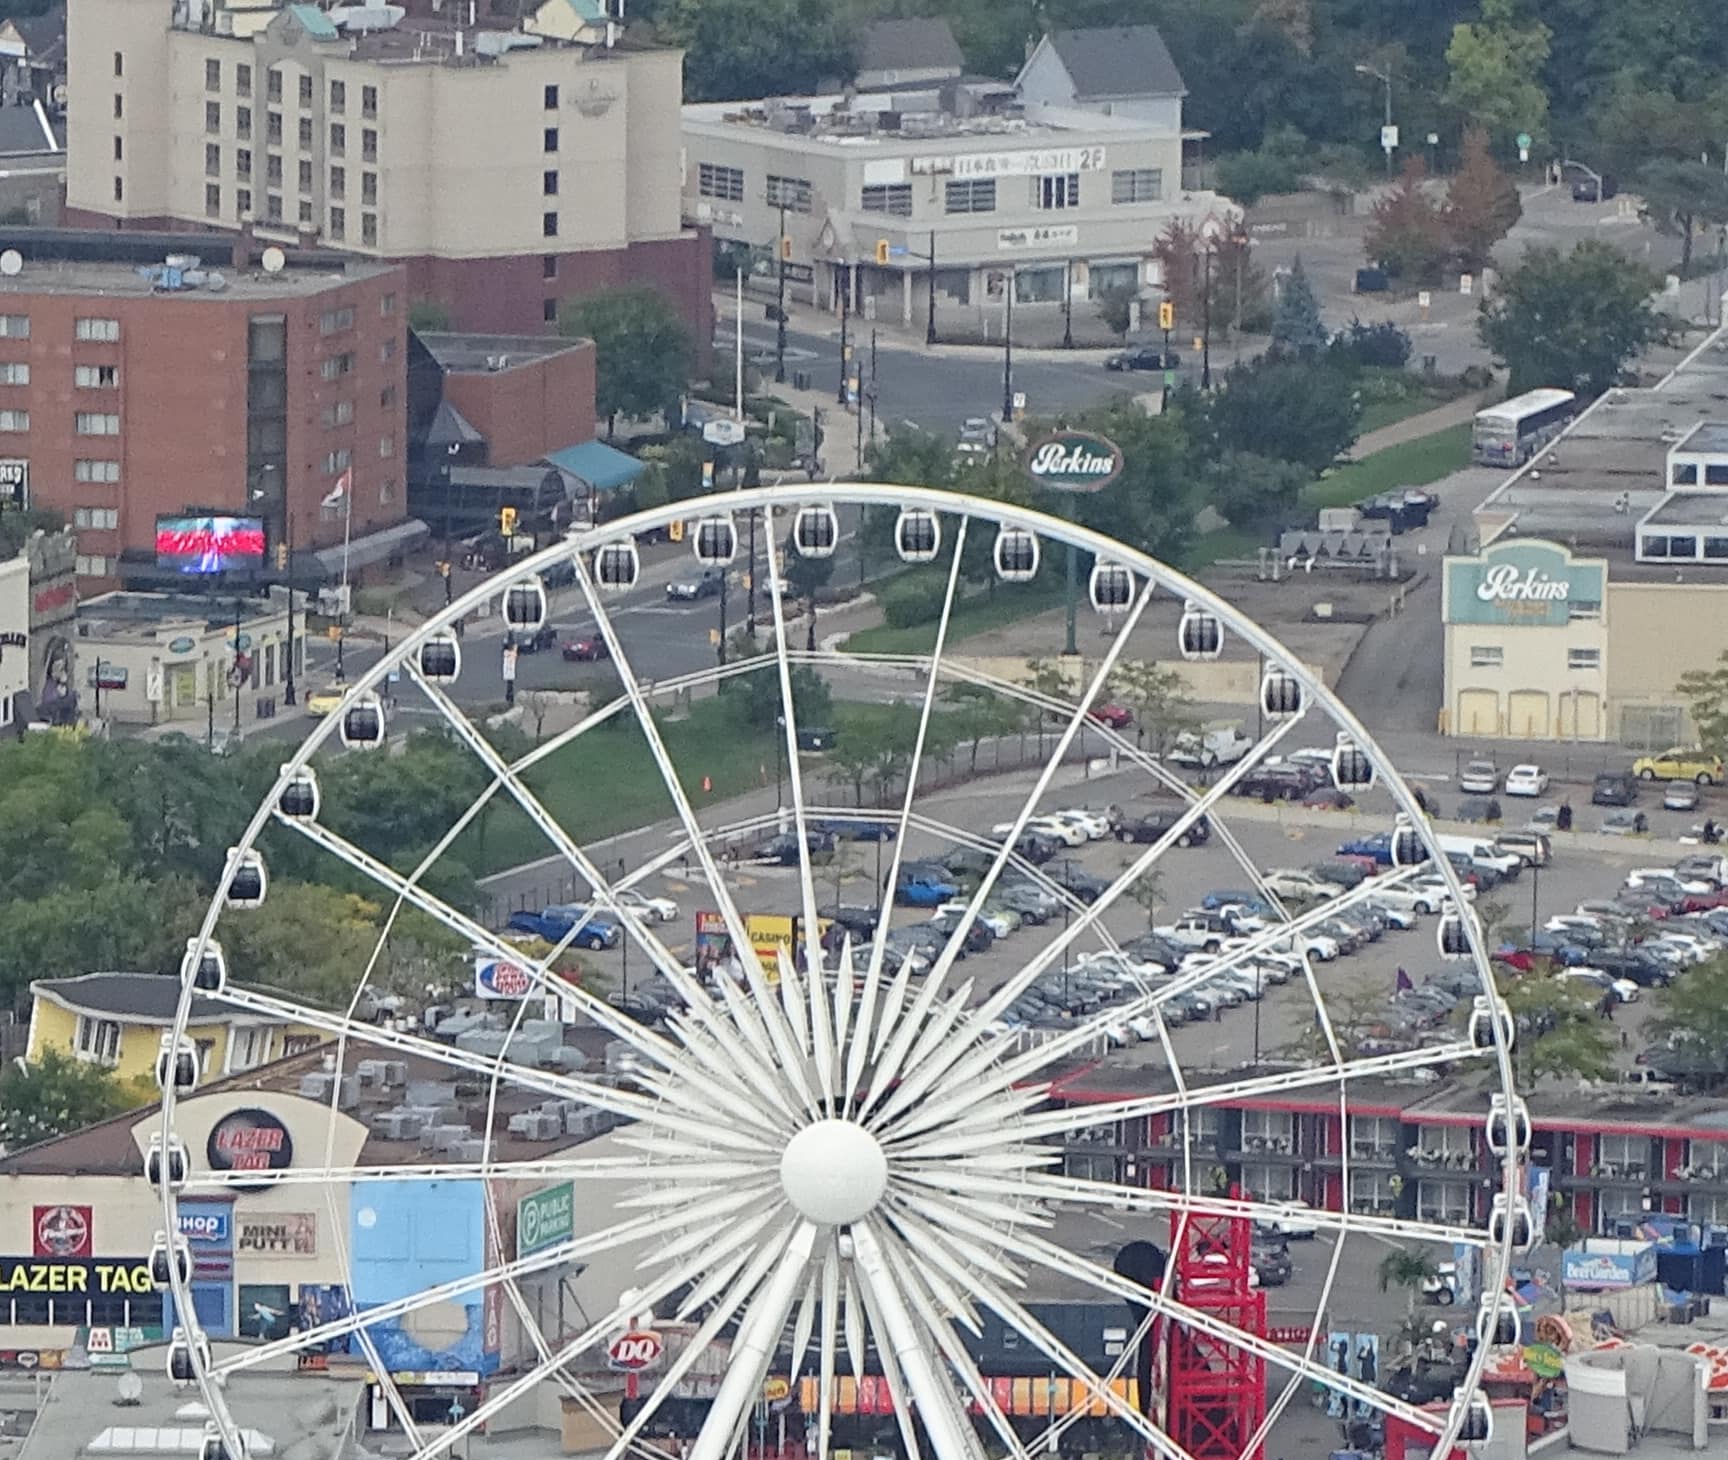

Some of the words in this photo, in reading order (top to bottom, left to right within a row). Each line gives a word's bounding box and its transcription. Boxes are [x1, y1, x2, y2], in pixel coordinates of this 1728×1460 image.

[1030, 441, 1115, 475] Perkins
[1476, 563, 1569, 601] Perkins
[215, 1128, 285, 1153] LAZER
[242, 1223, 288, 1238] MINI
[238, 1237, 296, 1251] PUTT
[95, 1265, 151, 1293] TAG
[617, 1340, 653, 1360] DQ
